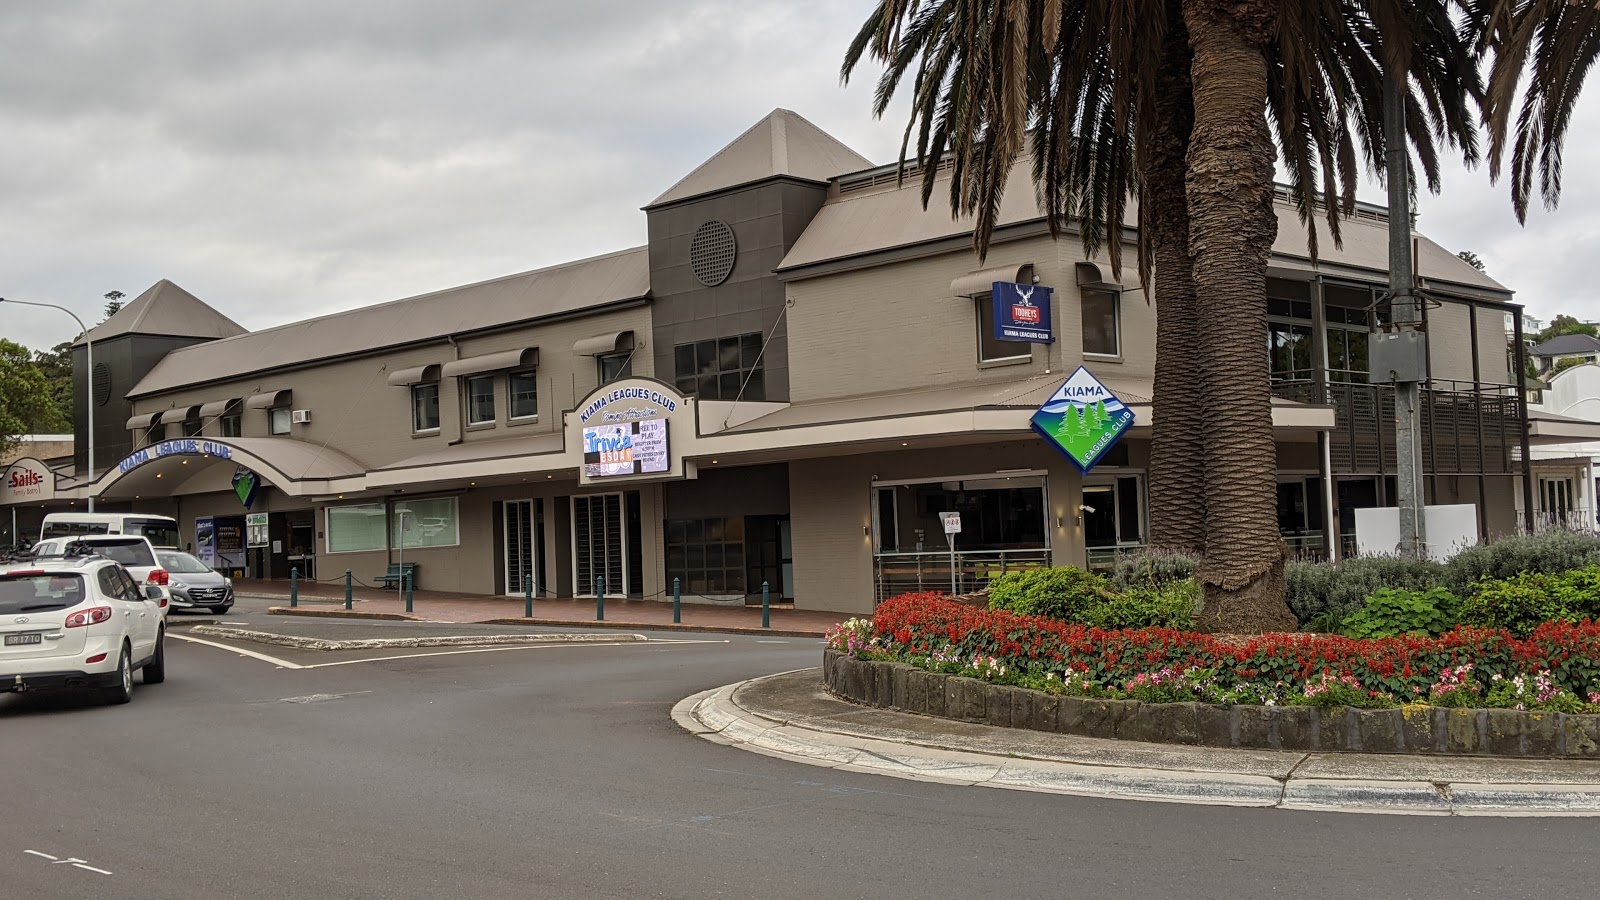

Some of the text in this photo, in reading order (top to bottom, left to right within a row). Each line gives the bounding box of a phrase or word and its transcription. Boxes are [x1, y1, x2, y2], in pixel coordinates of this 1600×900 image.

[1015, 308, 1037, 318] TOOHEYS
[1064, 386, 1104, 397] KIAMA
[580, 388, 676, 422] KIAMA LEAGUES CLUB
[602, 407, 657, 421] Coming Attractions
[585, 431, 632, 453] Trivia
[1081, 411, 1131, 464] LEAGUES CLUB
[119, 440, 231, 473] KIAMA LEAGUES CLUB
[601, 449, 632, 463] ESDAY
[12, 469, 39, 488] Sails
[13, 488, 26, 496] Family
